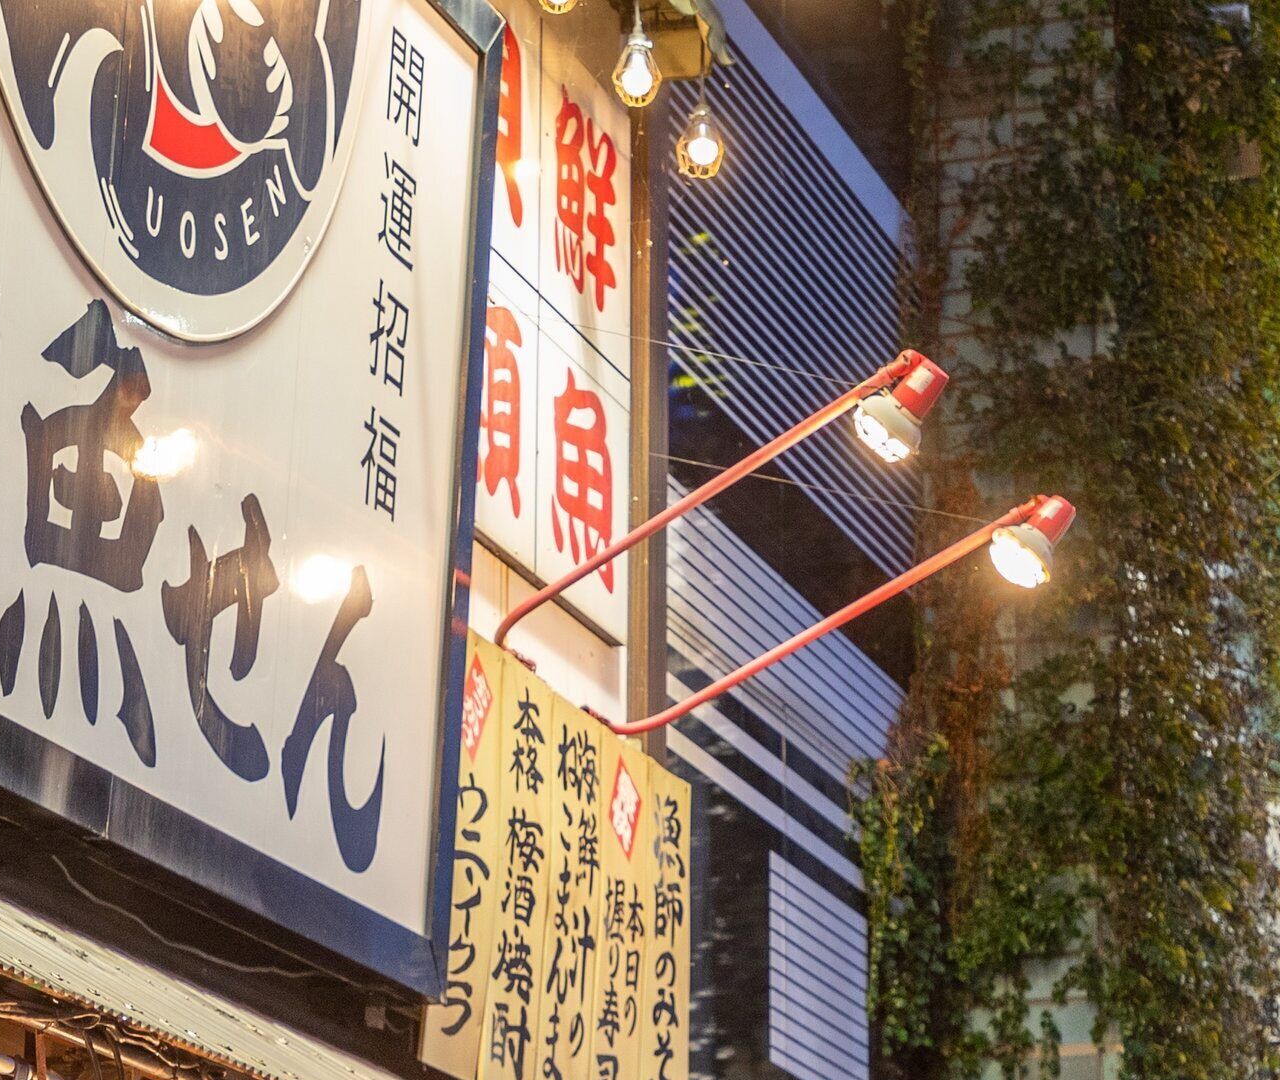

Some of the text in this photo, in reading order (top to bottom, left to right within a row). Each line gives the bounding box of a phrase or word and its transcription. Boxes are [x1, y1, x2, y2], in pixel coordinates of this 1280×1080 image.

[145, 164, 288, 261] UOSEN
[359, 26, 424, 523] 開運招福
[510, 686, 545, 795] 本格
[624, 880, 646, 1039] 本日の
